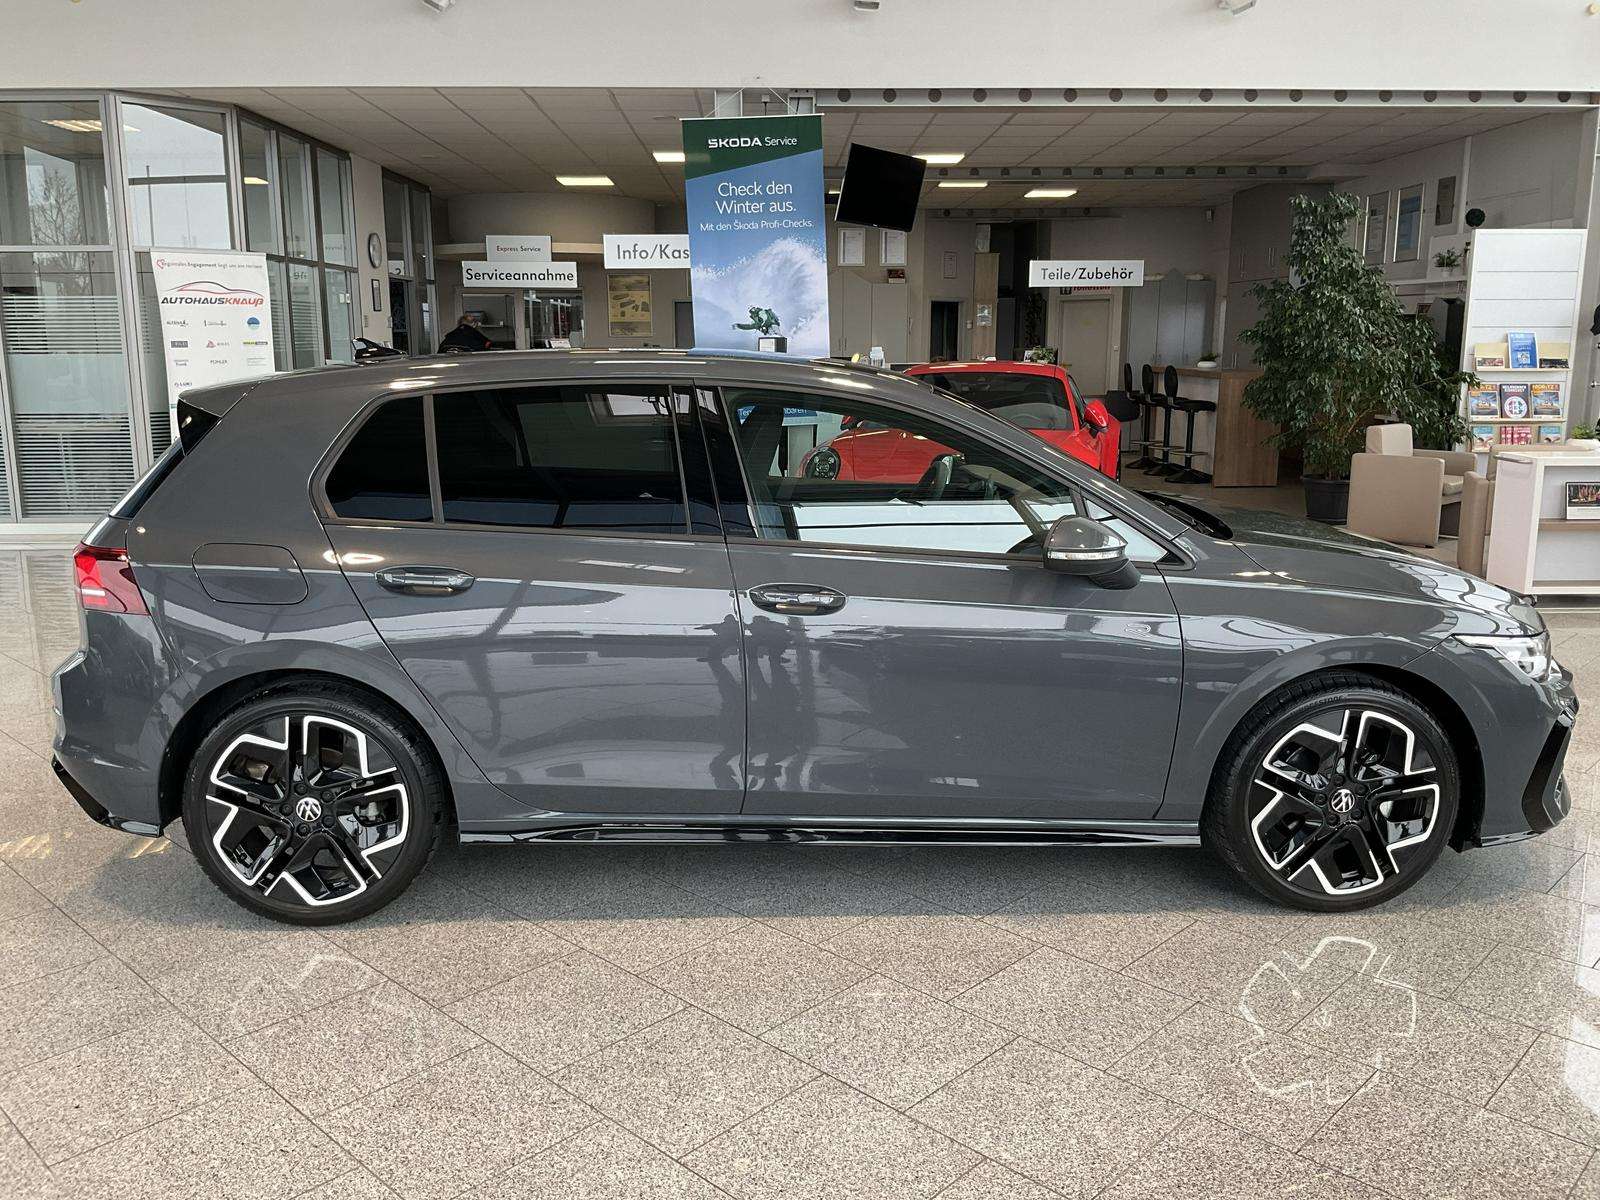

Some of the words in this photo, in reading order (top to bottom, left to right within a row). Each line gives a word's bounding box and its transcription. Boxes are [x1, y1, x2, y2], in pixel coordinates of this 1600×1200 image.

[764, 136, 798, 147] Service
[717, 181, 763, 197] Check
[766, 180, 793, 195] den
[715, 199, 765, 215] Winter
[769, 201, 797, 213] aus.
[700, 222, 716, 232] Mit
[717, 221, 732, 231] den
[734, 218, 759, 230] Škoda
[761, 218, 815, 229] Profi-Checks.
[496, 245, 518, 254] Express
[520, 244, 542, 253] Service
[617, 243, 690, 260] Info/Kas
[465, 268, 574, 281] Serviceannahme
[1040, 267, 1134, 280] Teile/Zubehör
